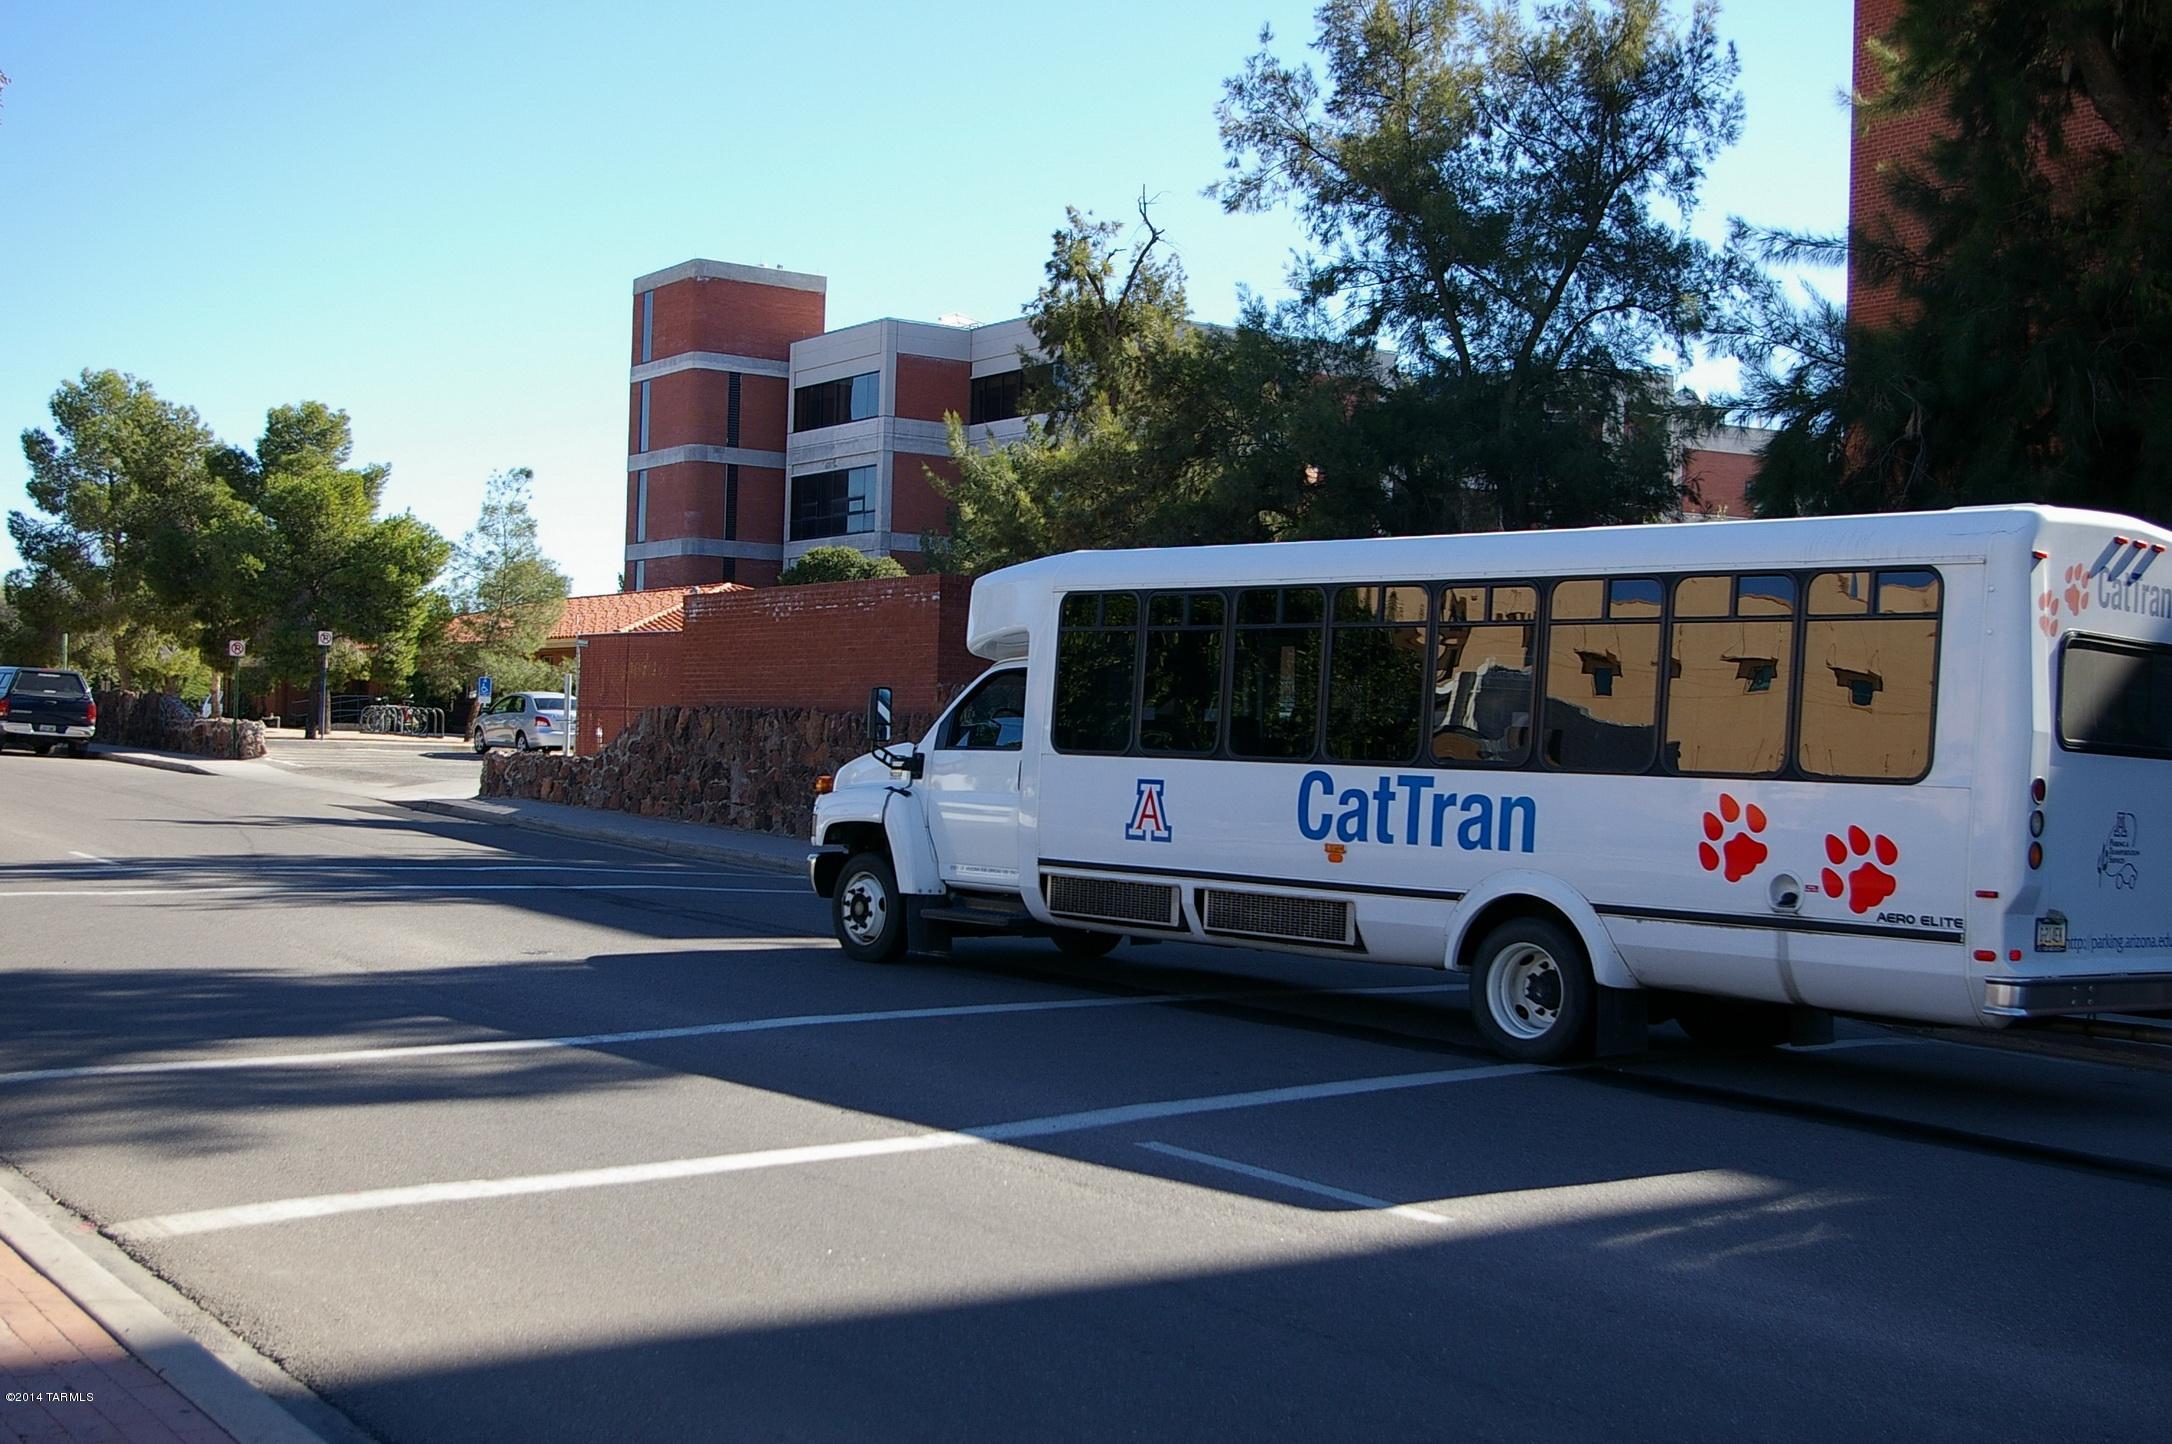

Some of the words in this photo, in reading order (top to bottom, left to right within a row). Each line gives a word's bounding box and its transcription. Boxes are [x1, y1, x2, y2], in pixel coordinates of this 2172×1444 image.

[2098, 566, 2172, 618] CatTran
[1125, 778, 1172, 843] A
[1297, 769, 1536, 853] CatTran
[1876, 912, 1916, 925] AERO
[1920, 916, 1964, 929] ELITE
